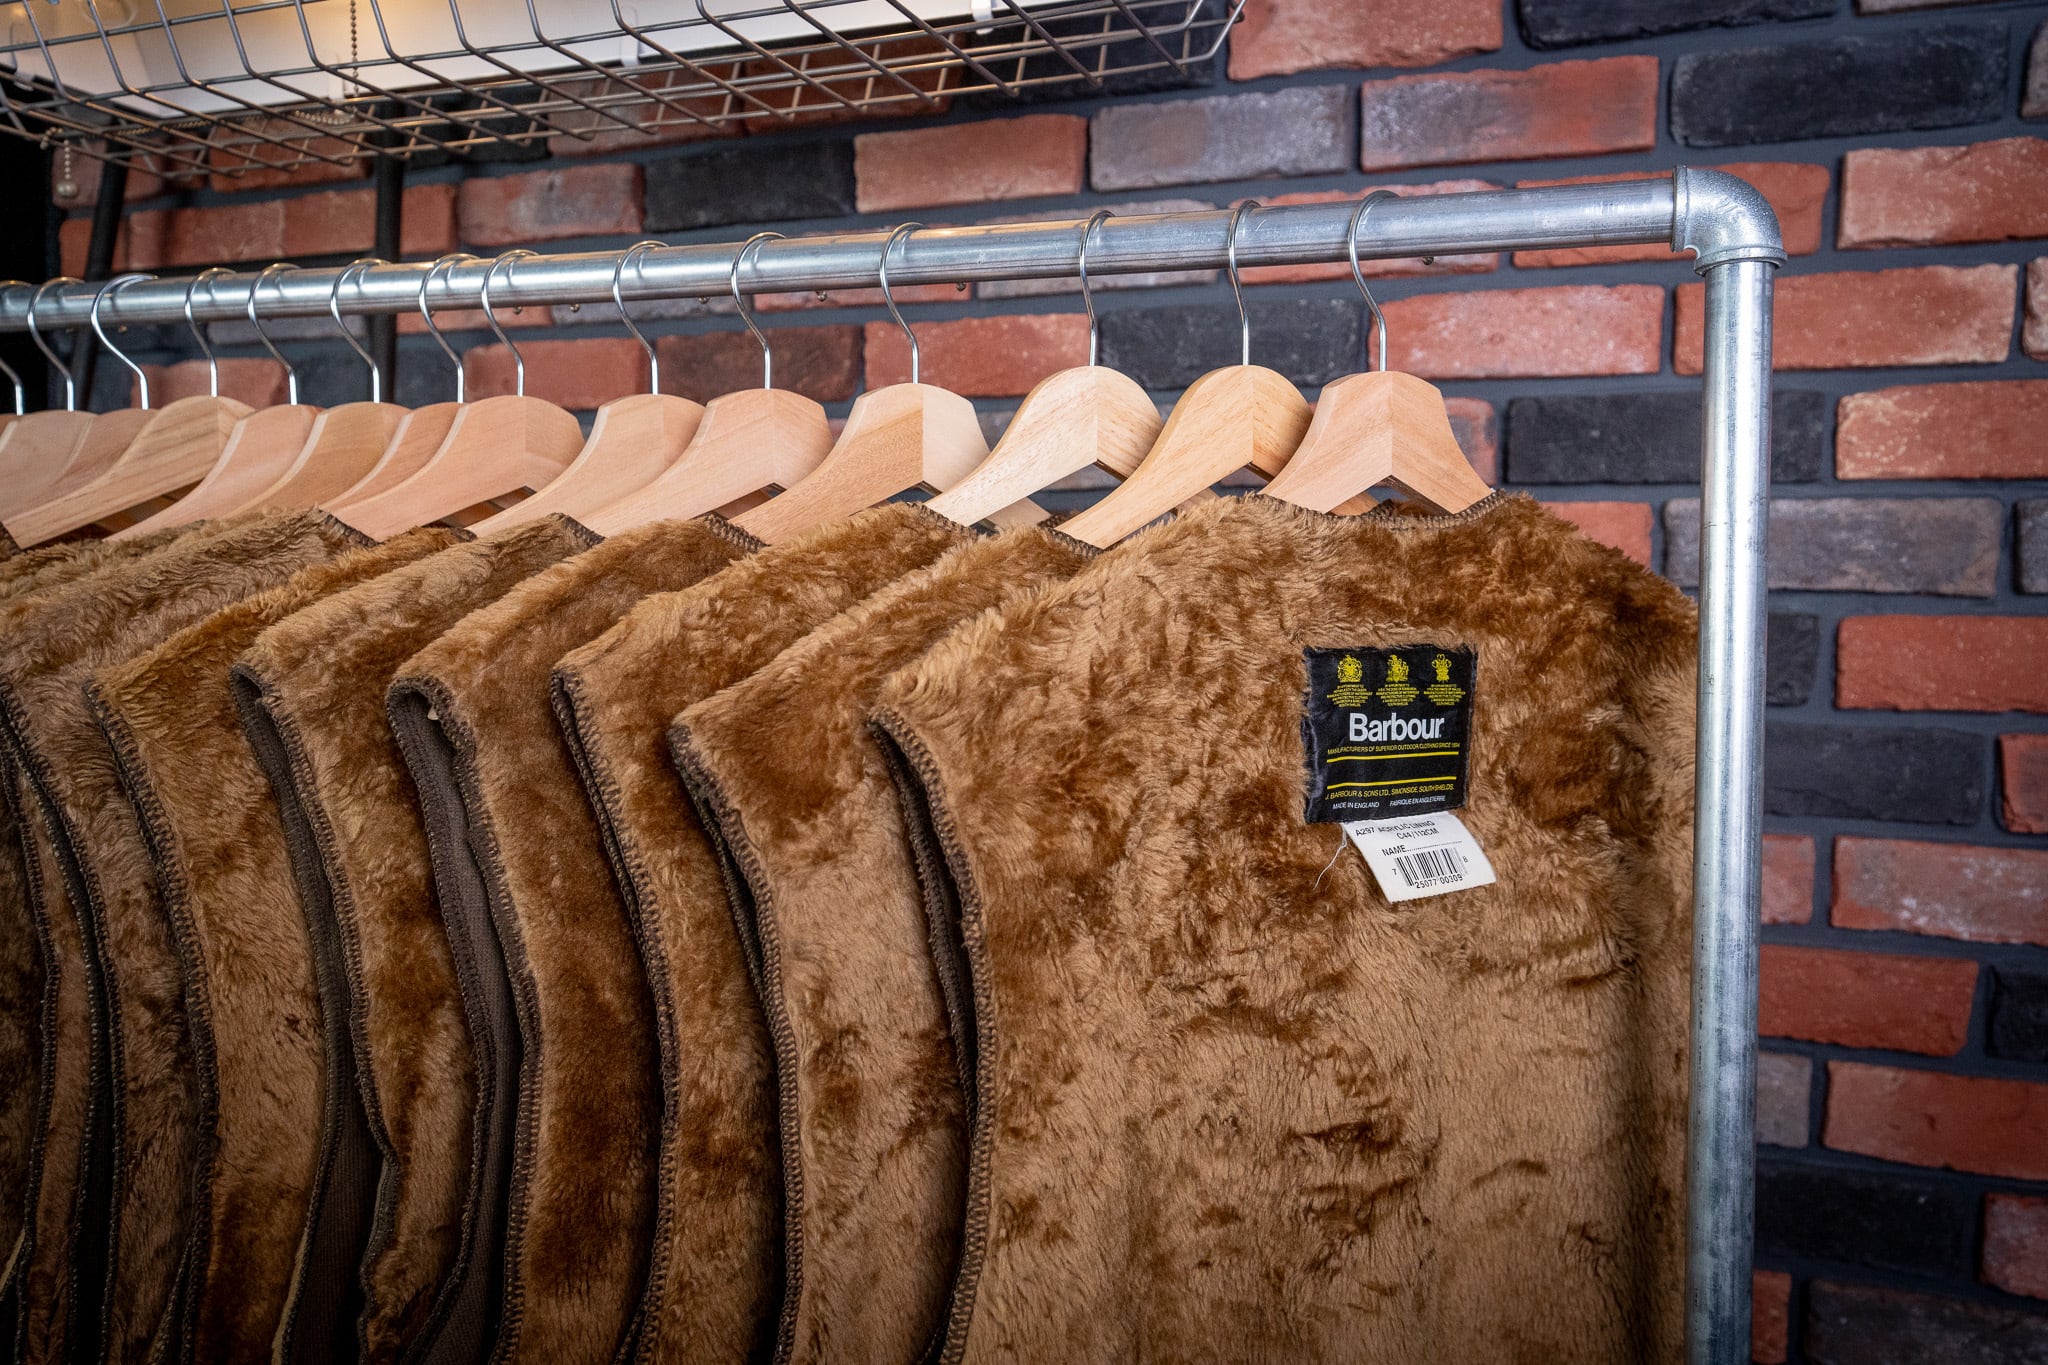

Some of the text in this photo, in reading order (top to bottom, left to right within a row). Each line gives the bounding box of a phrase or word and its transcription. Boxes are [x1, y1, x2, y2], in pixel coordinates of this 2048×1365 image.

[1349, 712, 1445, 742] Barbour
[1328, 745, 1368, 755] MANUFACTURERS
[1375, 744, 1397, 752] SUPERIOR
[1397, 743, 1419, 751] OUTDOOR
[1330, 790, 1358, 799] BARBOUR
[1358, 790, 1363, 798] &
[1363, 789, 1378, 798] SONS
[1354, 801, 1380, 809] ENGLAND
[1355, 826, 1375, 836] A297
[1377, 823, 1411, 833] ACRYLIC
[1391, 868, 1397, 876] 7
[1414, 873, 1463, 889] 25077 00309
